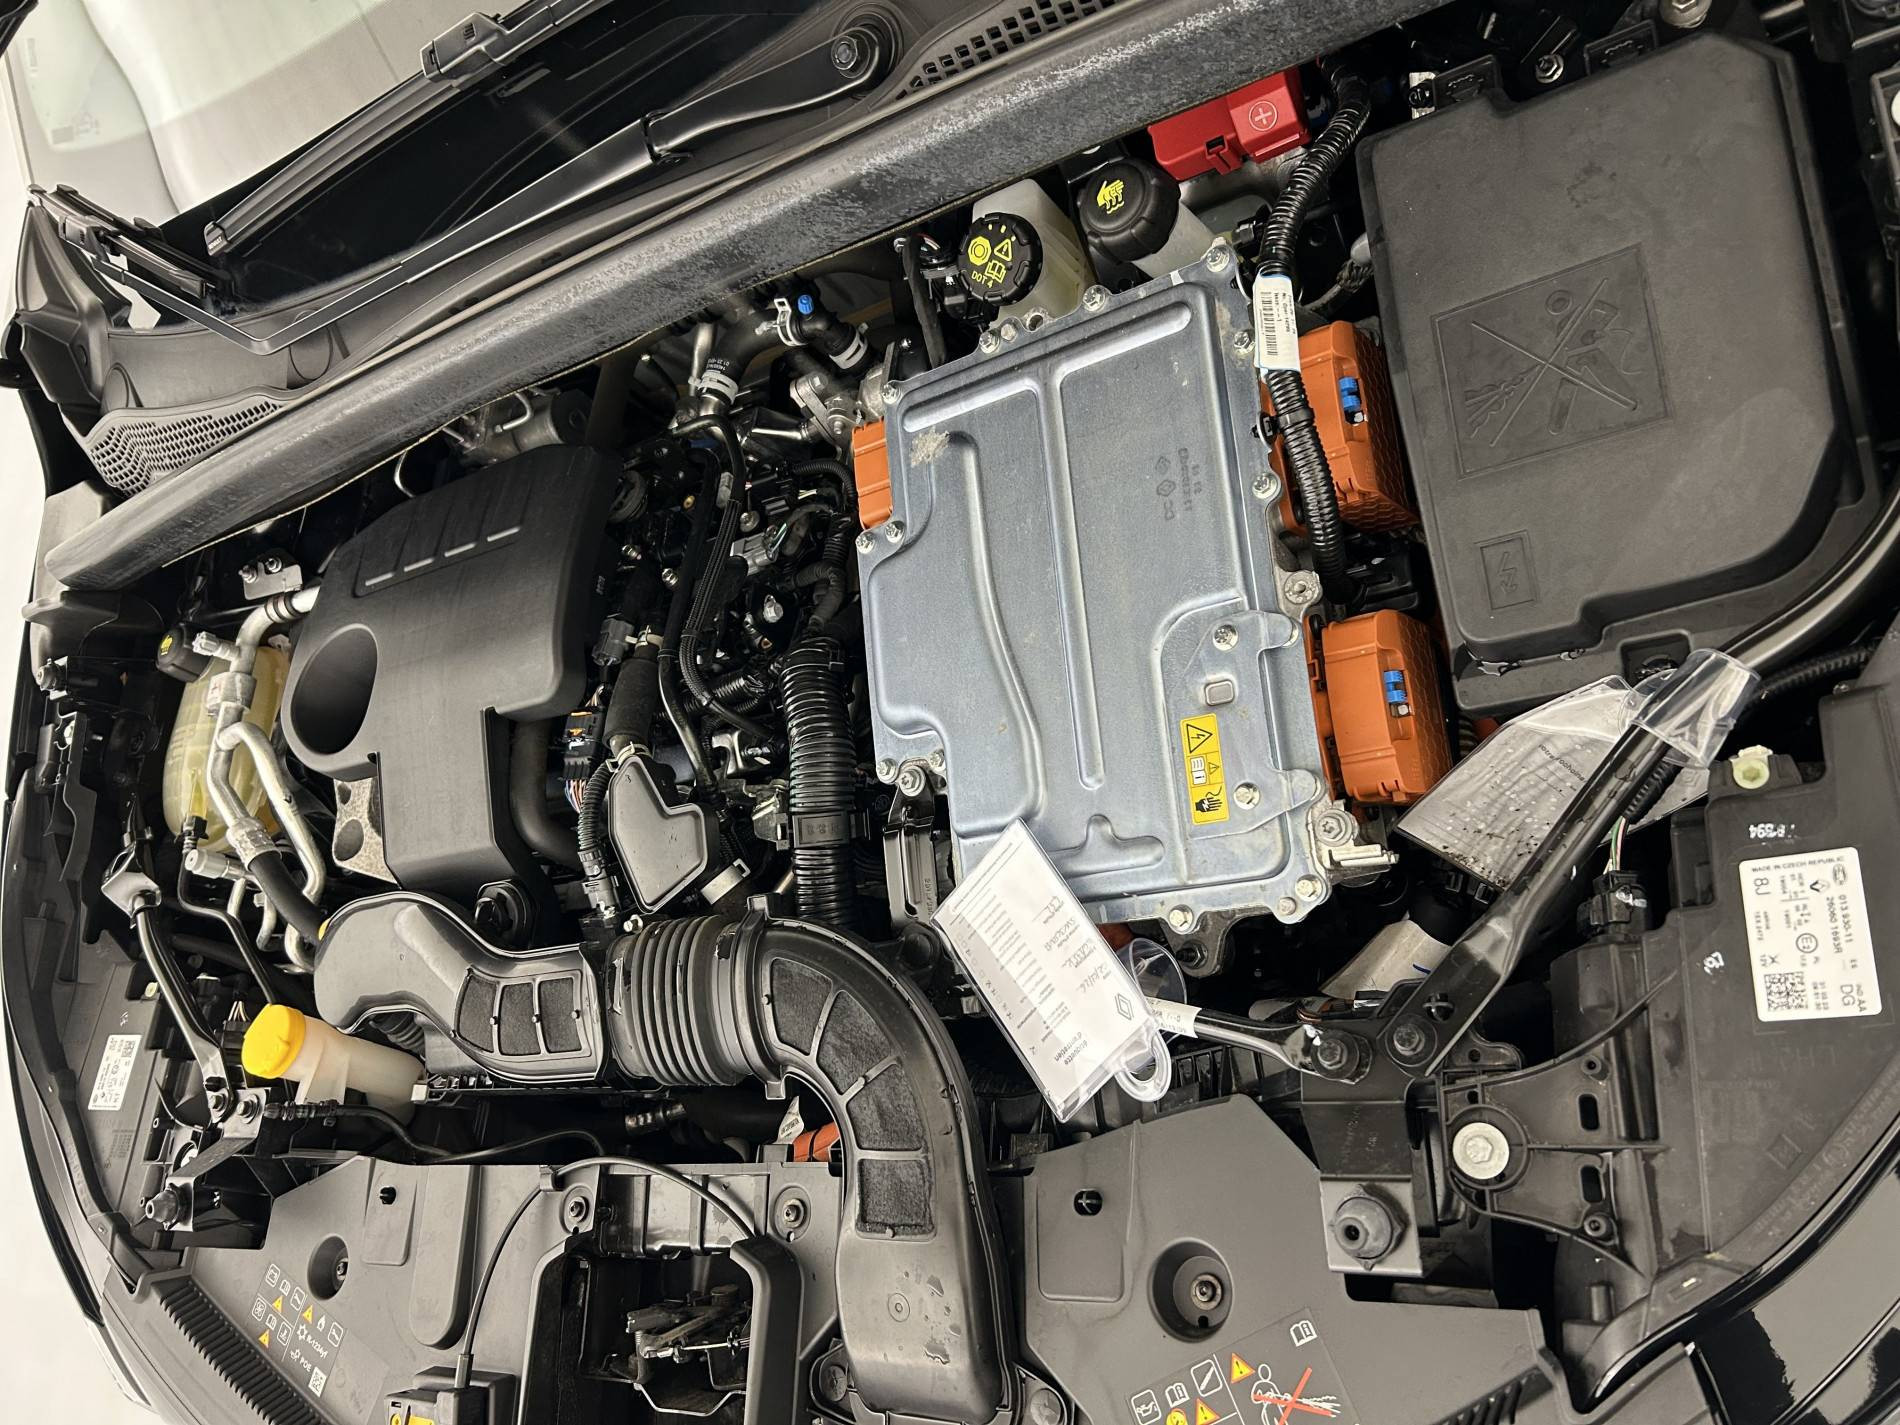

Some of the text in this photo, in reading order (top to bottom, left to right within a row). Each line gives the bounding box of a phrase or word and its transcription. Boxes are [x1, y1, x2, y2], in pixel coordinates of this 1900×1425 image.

[971, 270, 994, 288] DOT 4
[1751, 864, 1770, 872] MADE
[1782, 860, 1806, 868] CZECH
[1808, 855, 1844, 865] REPUBLIC
[1753, 876, 1770, 896] 8J
[1839, 983, 1855, 1006] DG
[1856, 998, 1866, 1012] AA
[300, 1357, 312, 1372] POE
